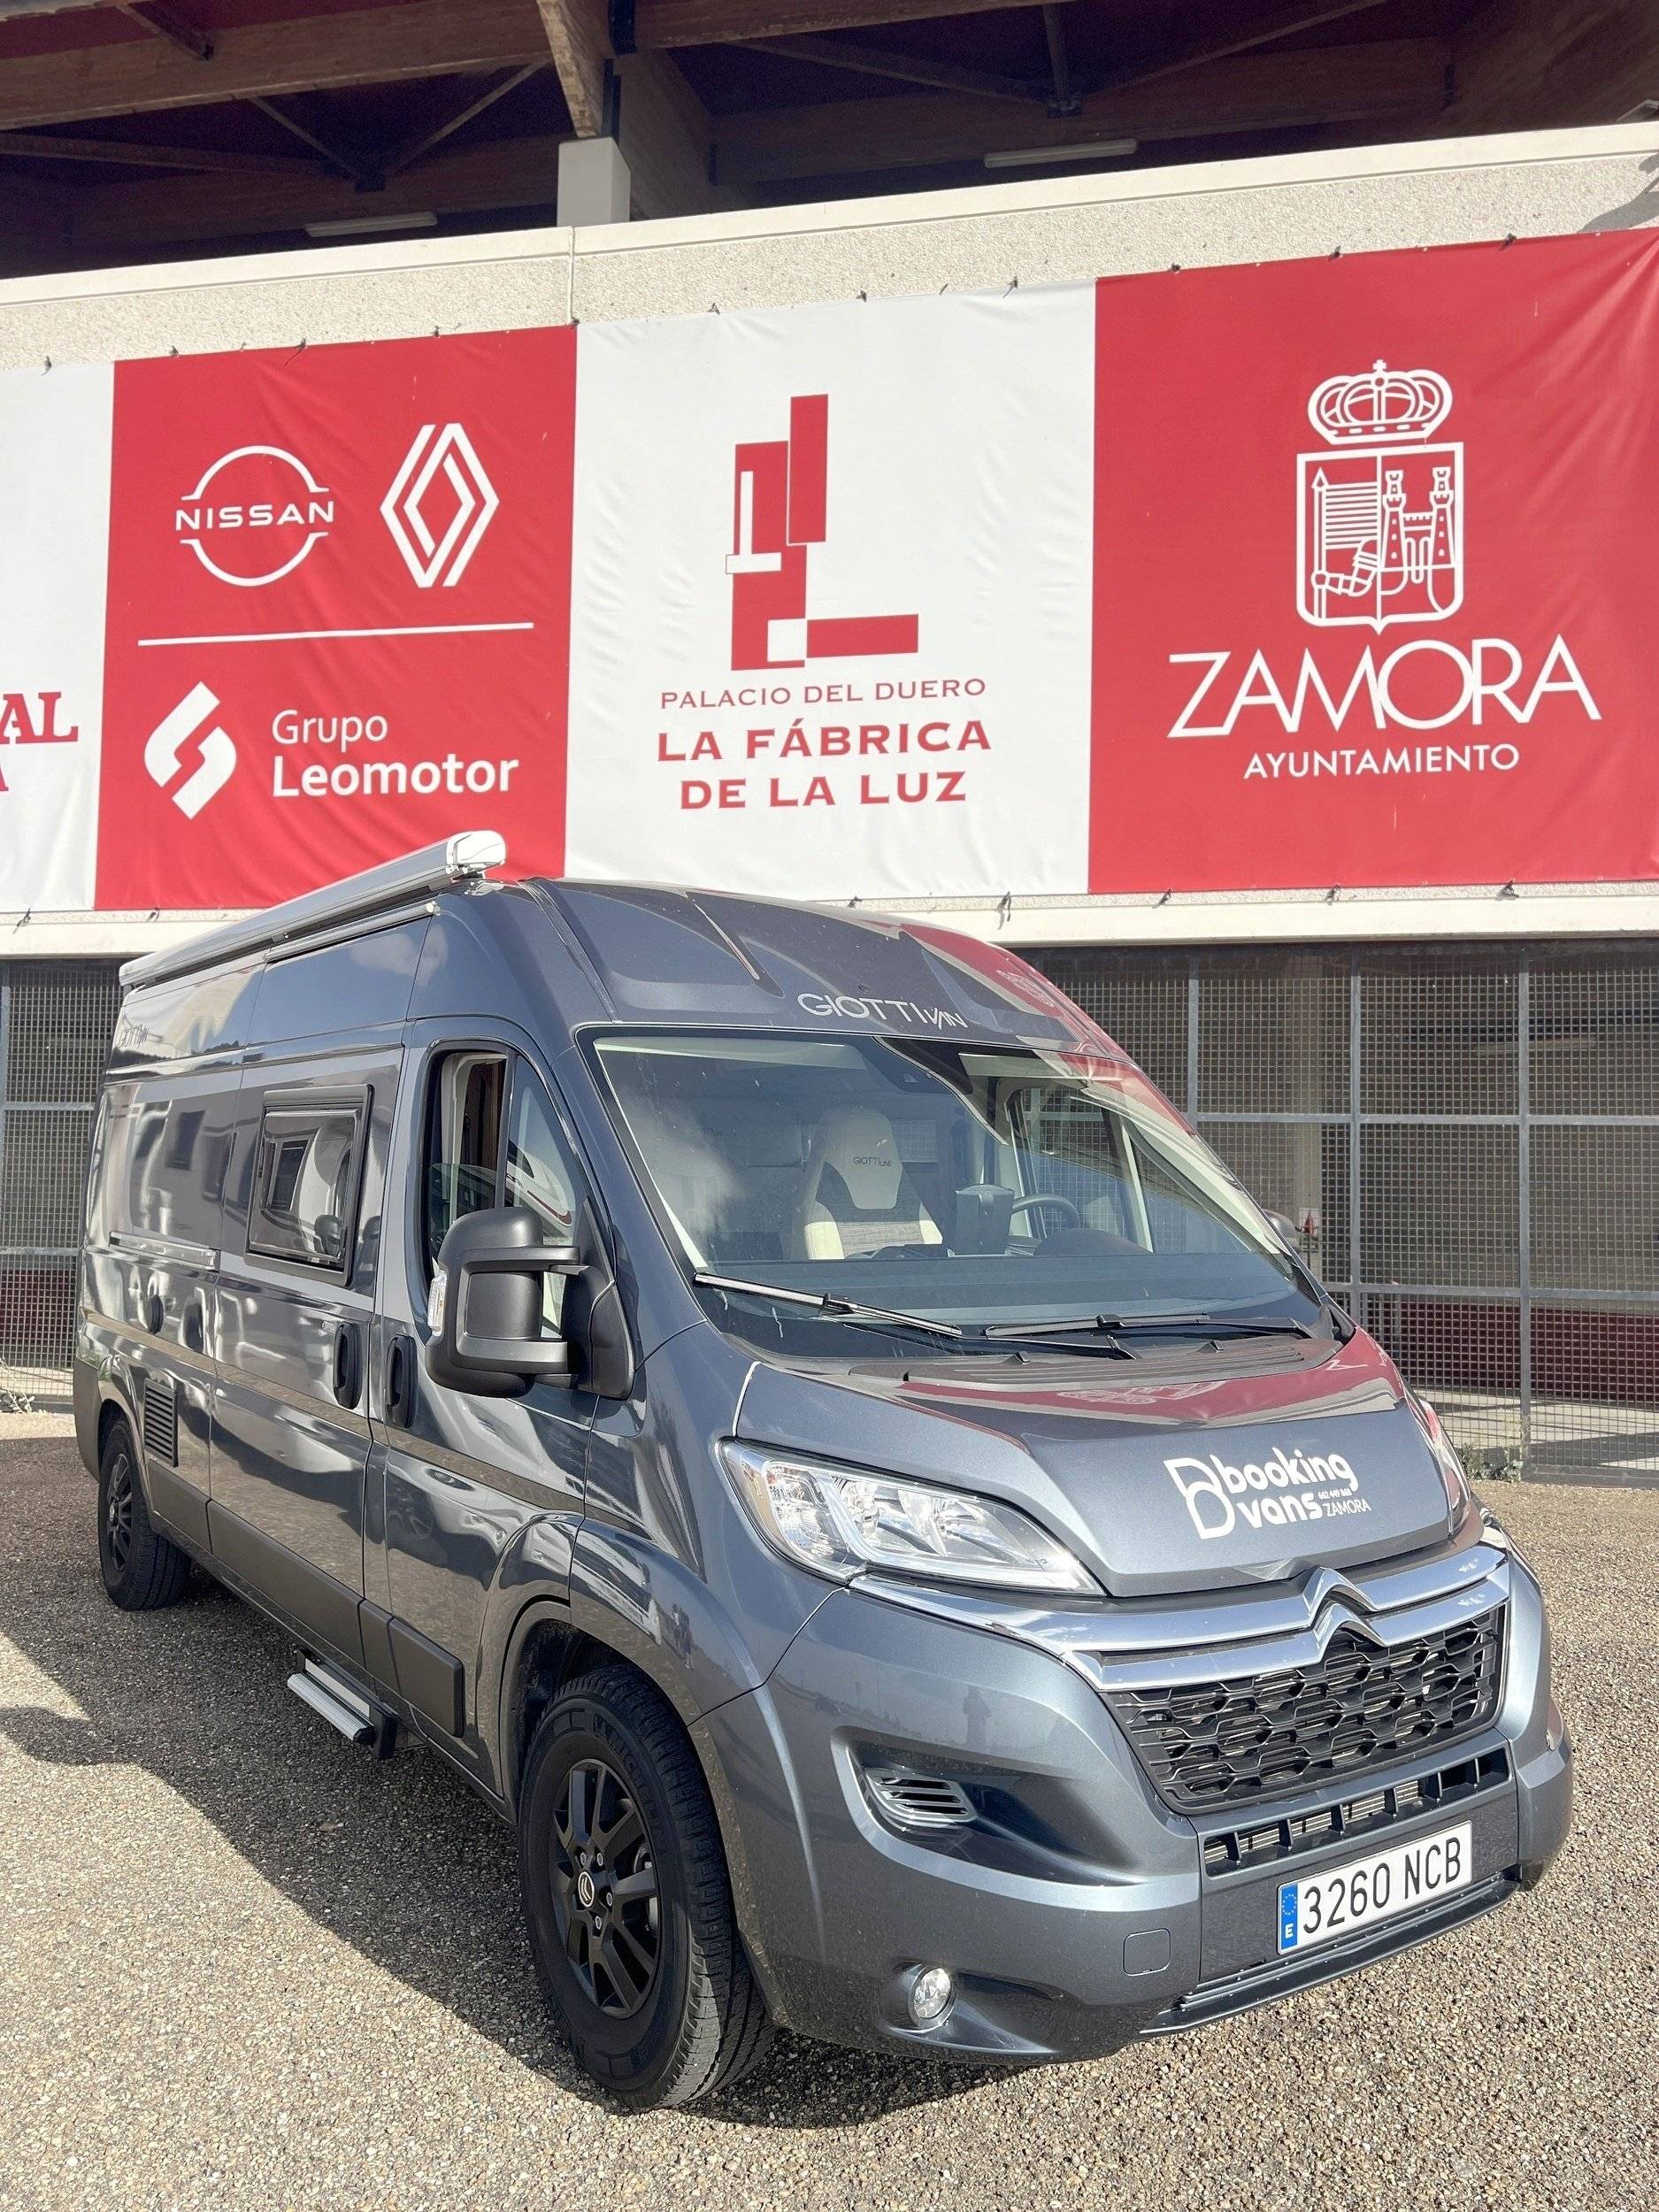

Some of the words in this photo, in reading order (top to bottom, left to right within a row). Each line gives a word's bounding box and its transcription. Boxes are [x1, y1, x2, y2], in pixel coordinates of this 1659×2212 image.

[175, 500, 334, 531] NISSAN
[660, 686, 792, 710] PALACIO
[803, 684, 864, 703] DEL
[874, 678, 987, 701] DUERO
[1167, 634, 1602, 738] ZAMORA
[272, 709, 388, 753] Grupo
[657, 731, 723, 763] LA
[746, 718, 992, 759] FÁBRICA
[273, 753, 520, 798] Leomotor
[1243, 743, 1519, 780] AYUNTAMIENTO
[680, 779, 746, 810] DE
[769, 776, 836, 808] LA
[859, 771, 966, 805] LUZ
[1209, 1446, 1359, 1493] booking
[1236, 1490, 1324, 1529] vans
[1322, 1497, 1373, 1517] ZAMORA
[1284, 1923, 1294, 1939] E
[1302, 1862, 1392, 1934] 3260
[1404, 1836, 1463, 1900] NCB
